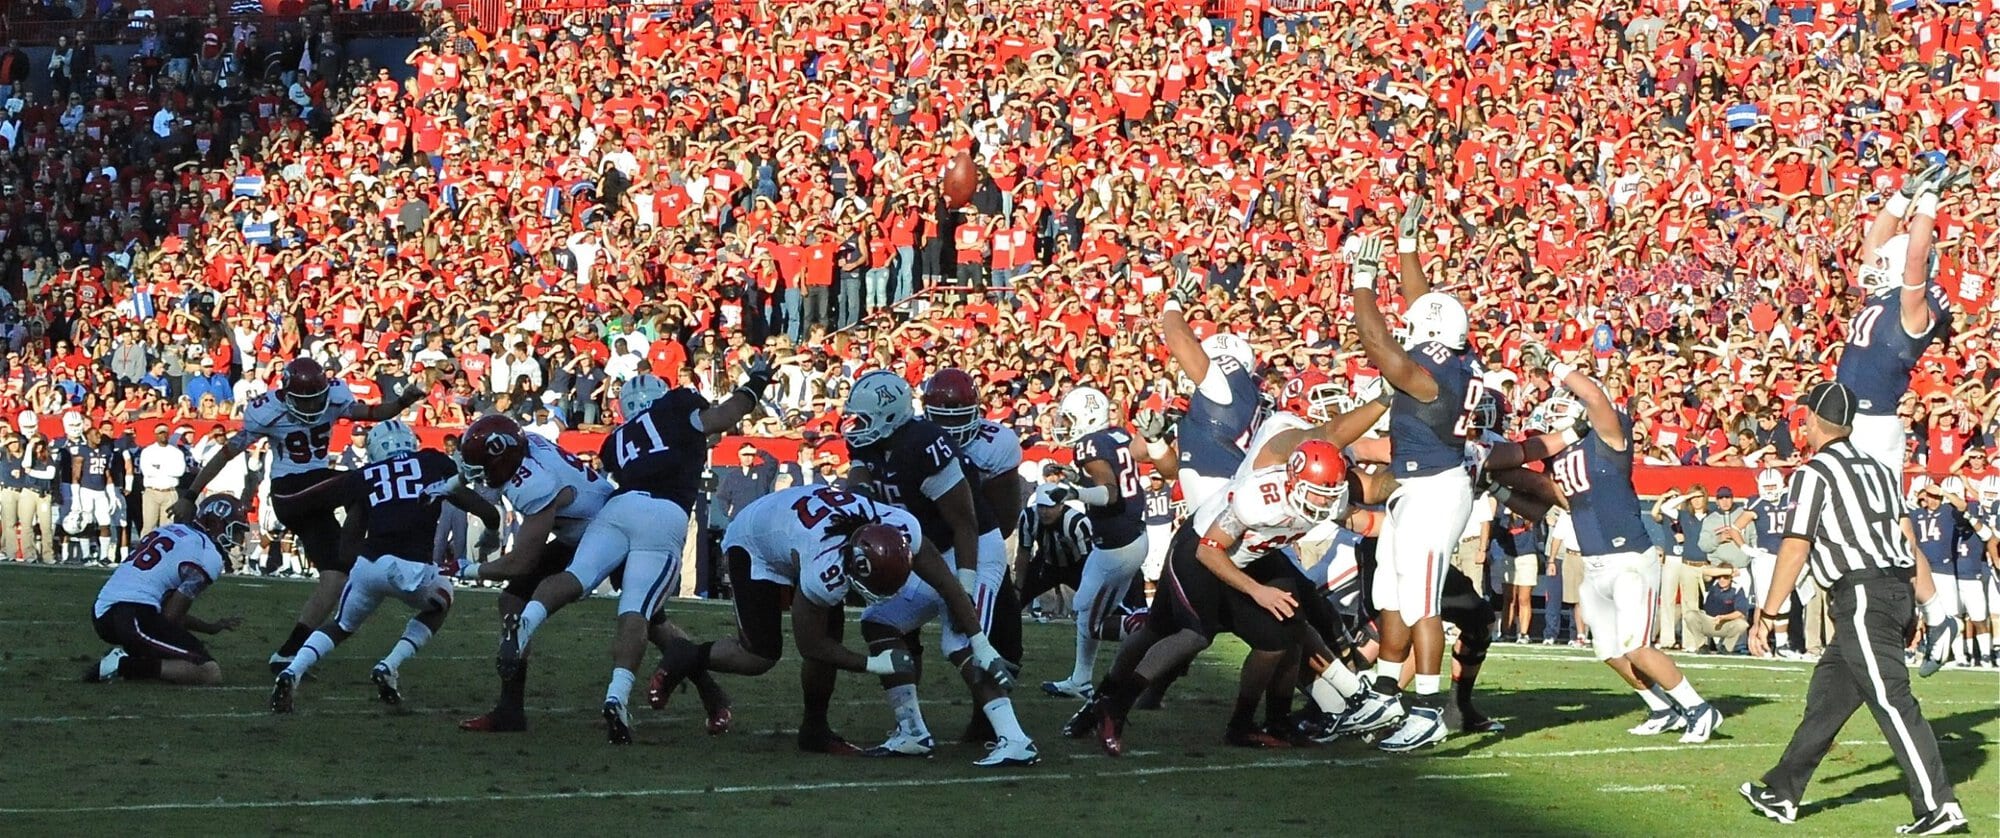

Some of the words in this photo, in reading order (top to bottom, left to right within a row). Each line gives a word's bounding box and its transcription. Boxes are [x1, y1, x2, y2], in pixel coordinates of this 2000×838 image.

[875, 385, 897, 407] A
[284, 422, 330, 464] 95
[615, 412, 669, 469] 41
[926, 436, 953, 467] 75
[1076, 439, 1097, 461] 24
[363, 458, 423, 507] 32
[1116, 446, 1139, 498] 2
[1146, 495, 1169, 518] 30
[1259, 483, 1281, 505] 62
[1767, 512, 1788, 534] 19
[1917, 518, 1941, 543] 14
